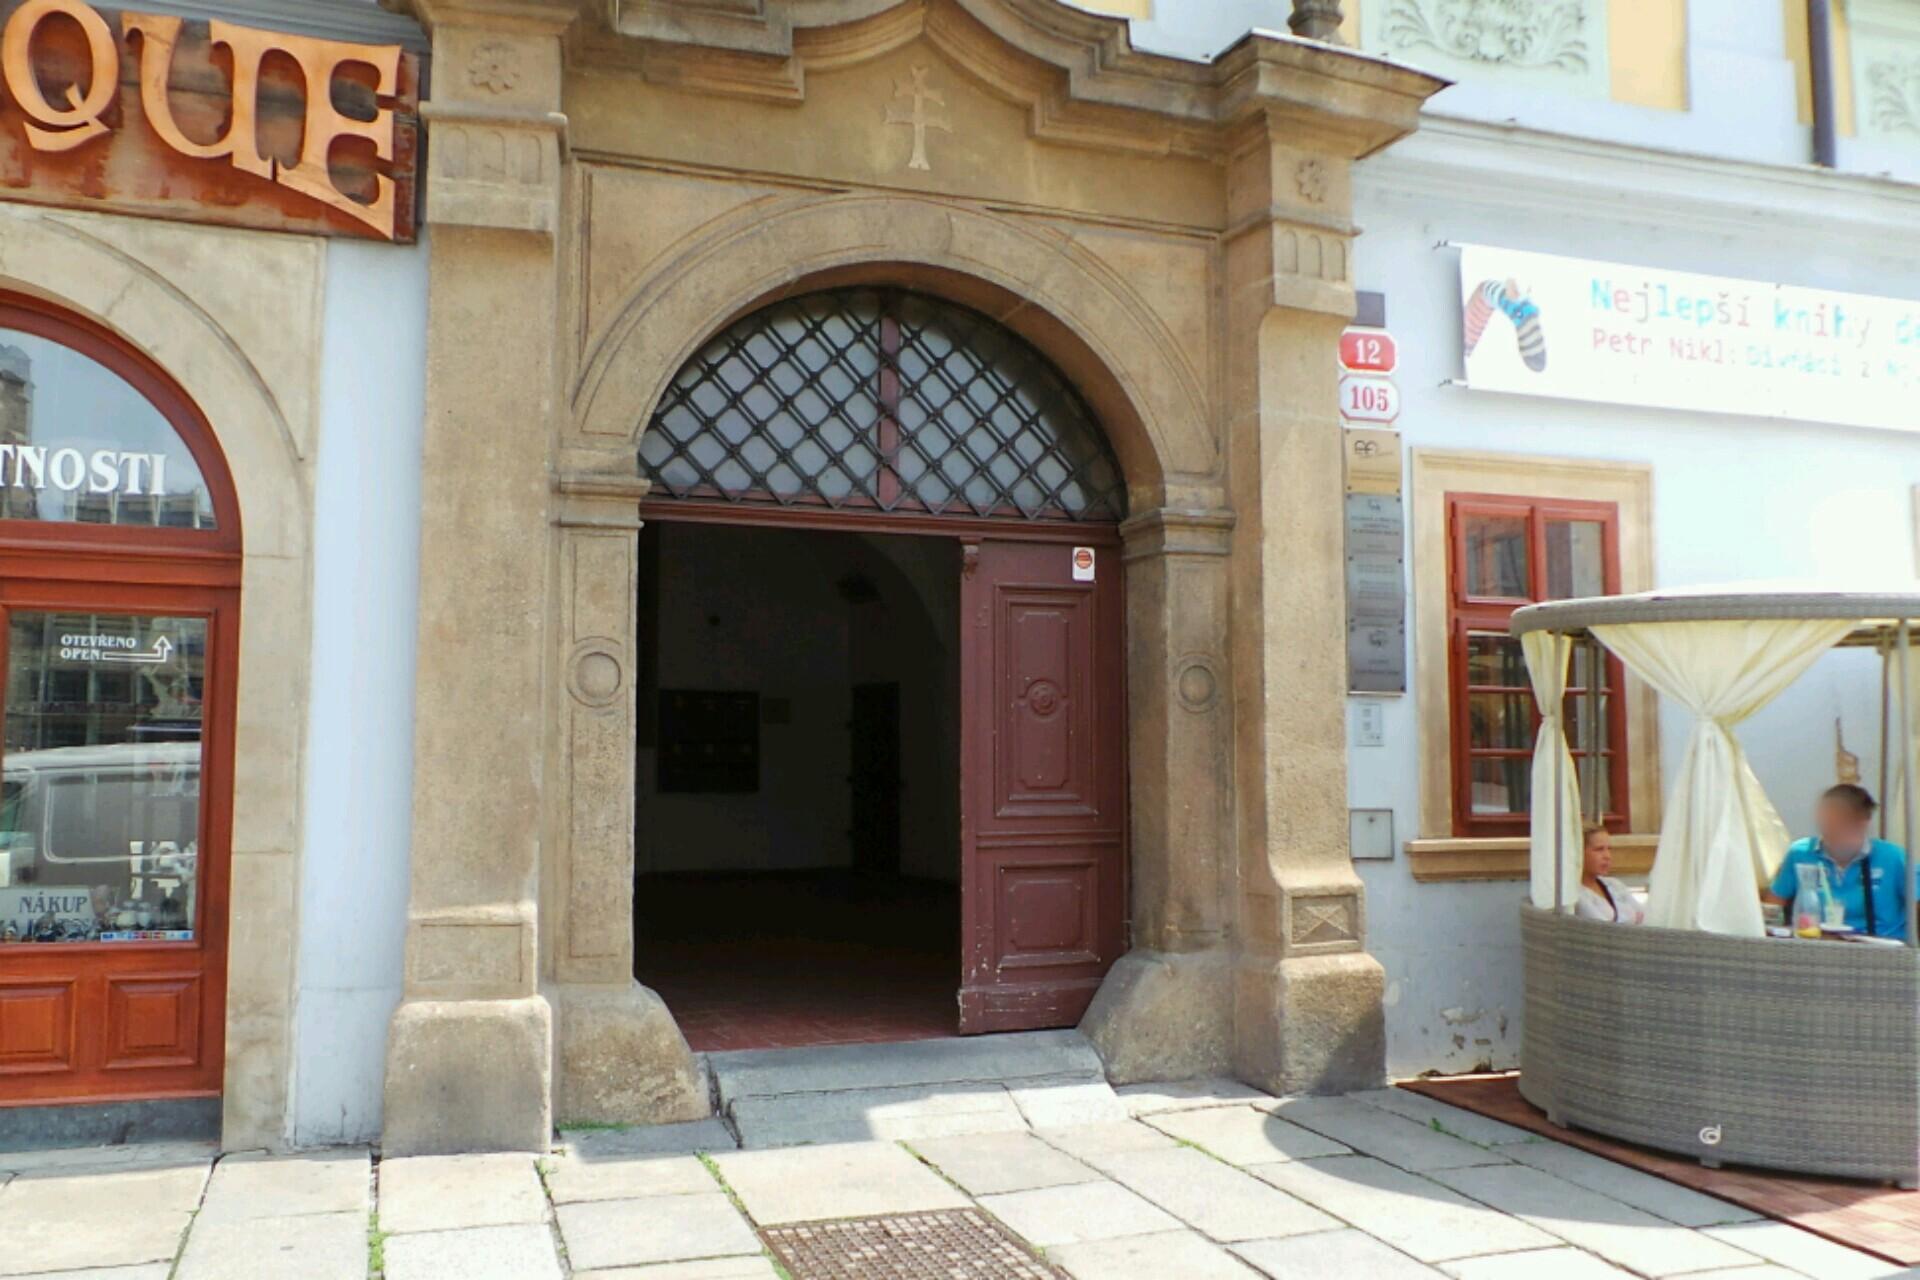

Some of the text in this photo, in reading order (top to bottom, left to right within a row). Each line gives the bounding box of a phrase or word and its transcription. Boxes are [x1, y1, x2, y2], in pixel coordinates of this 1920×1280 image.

[1592, 279, 1750, 328] Nejlepší
[1356, 338, 1381, 365] 12
[1593, 327, 1652, 355] Petr
[1350, 386, 1390, 412] 105
[60, 633, 137, 649] OTEVŘENO
[60, 647, 101, 660] OPEN
[19, 890, 88, 914] NÁKUP
